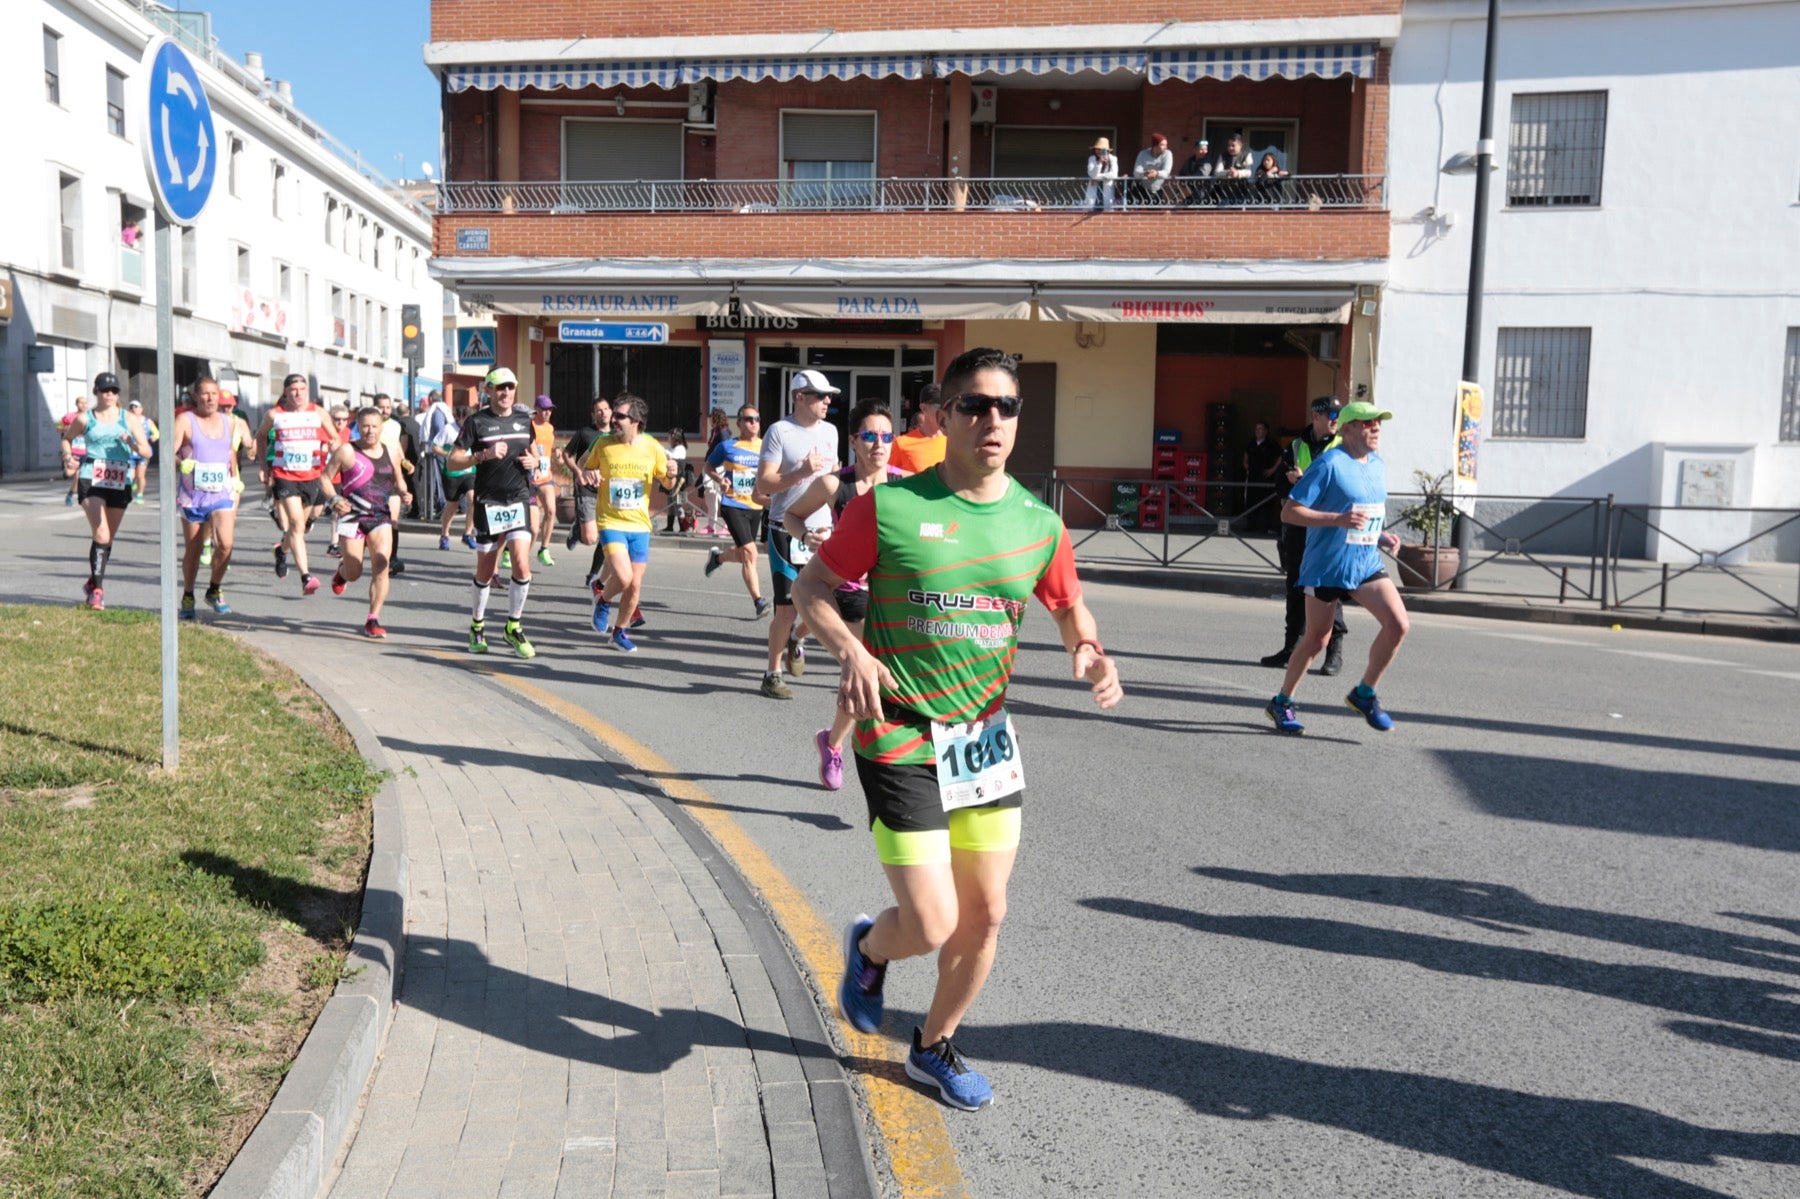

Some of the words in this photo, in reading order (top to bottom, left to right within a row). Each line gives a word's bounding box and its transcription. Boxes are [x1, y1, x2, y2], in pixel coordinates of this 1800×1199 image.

[541, 294, 679, 311] RESTAURANTE
[837, 296, 921, 314] PARADA
[562, 327, 604, 337] Granada
[626, 329, 648, 337] A-44
[288, 453, 308, 463] 793
[609, 463, 648, 471] agustinos
[95, 468, 125, 482] 2031
[201, 472, 223, 483] 539
[615, 487, 638, 500] 491
[494, 508, 518, 522] 497
[1369, 517, 1381, 531] 77
[942, 729, 1014, 778] 1019
